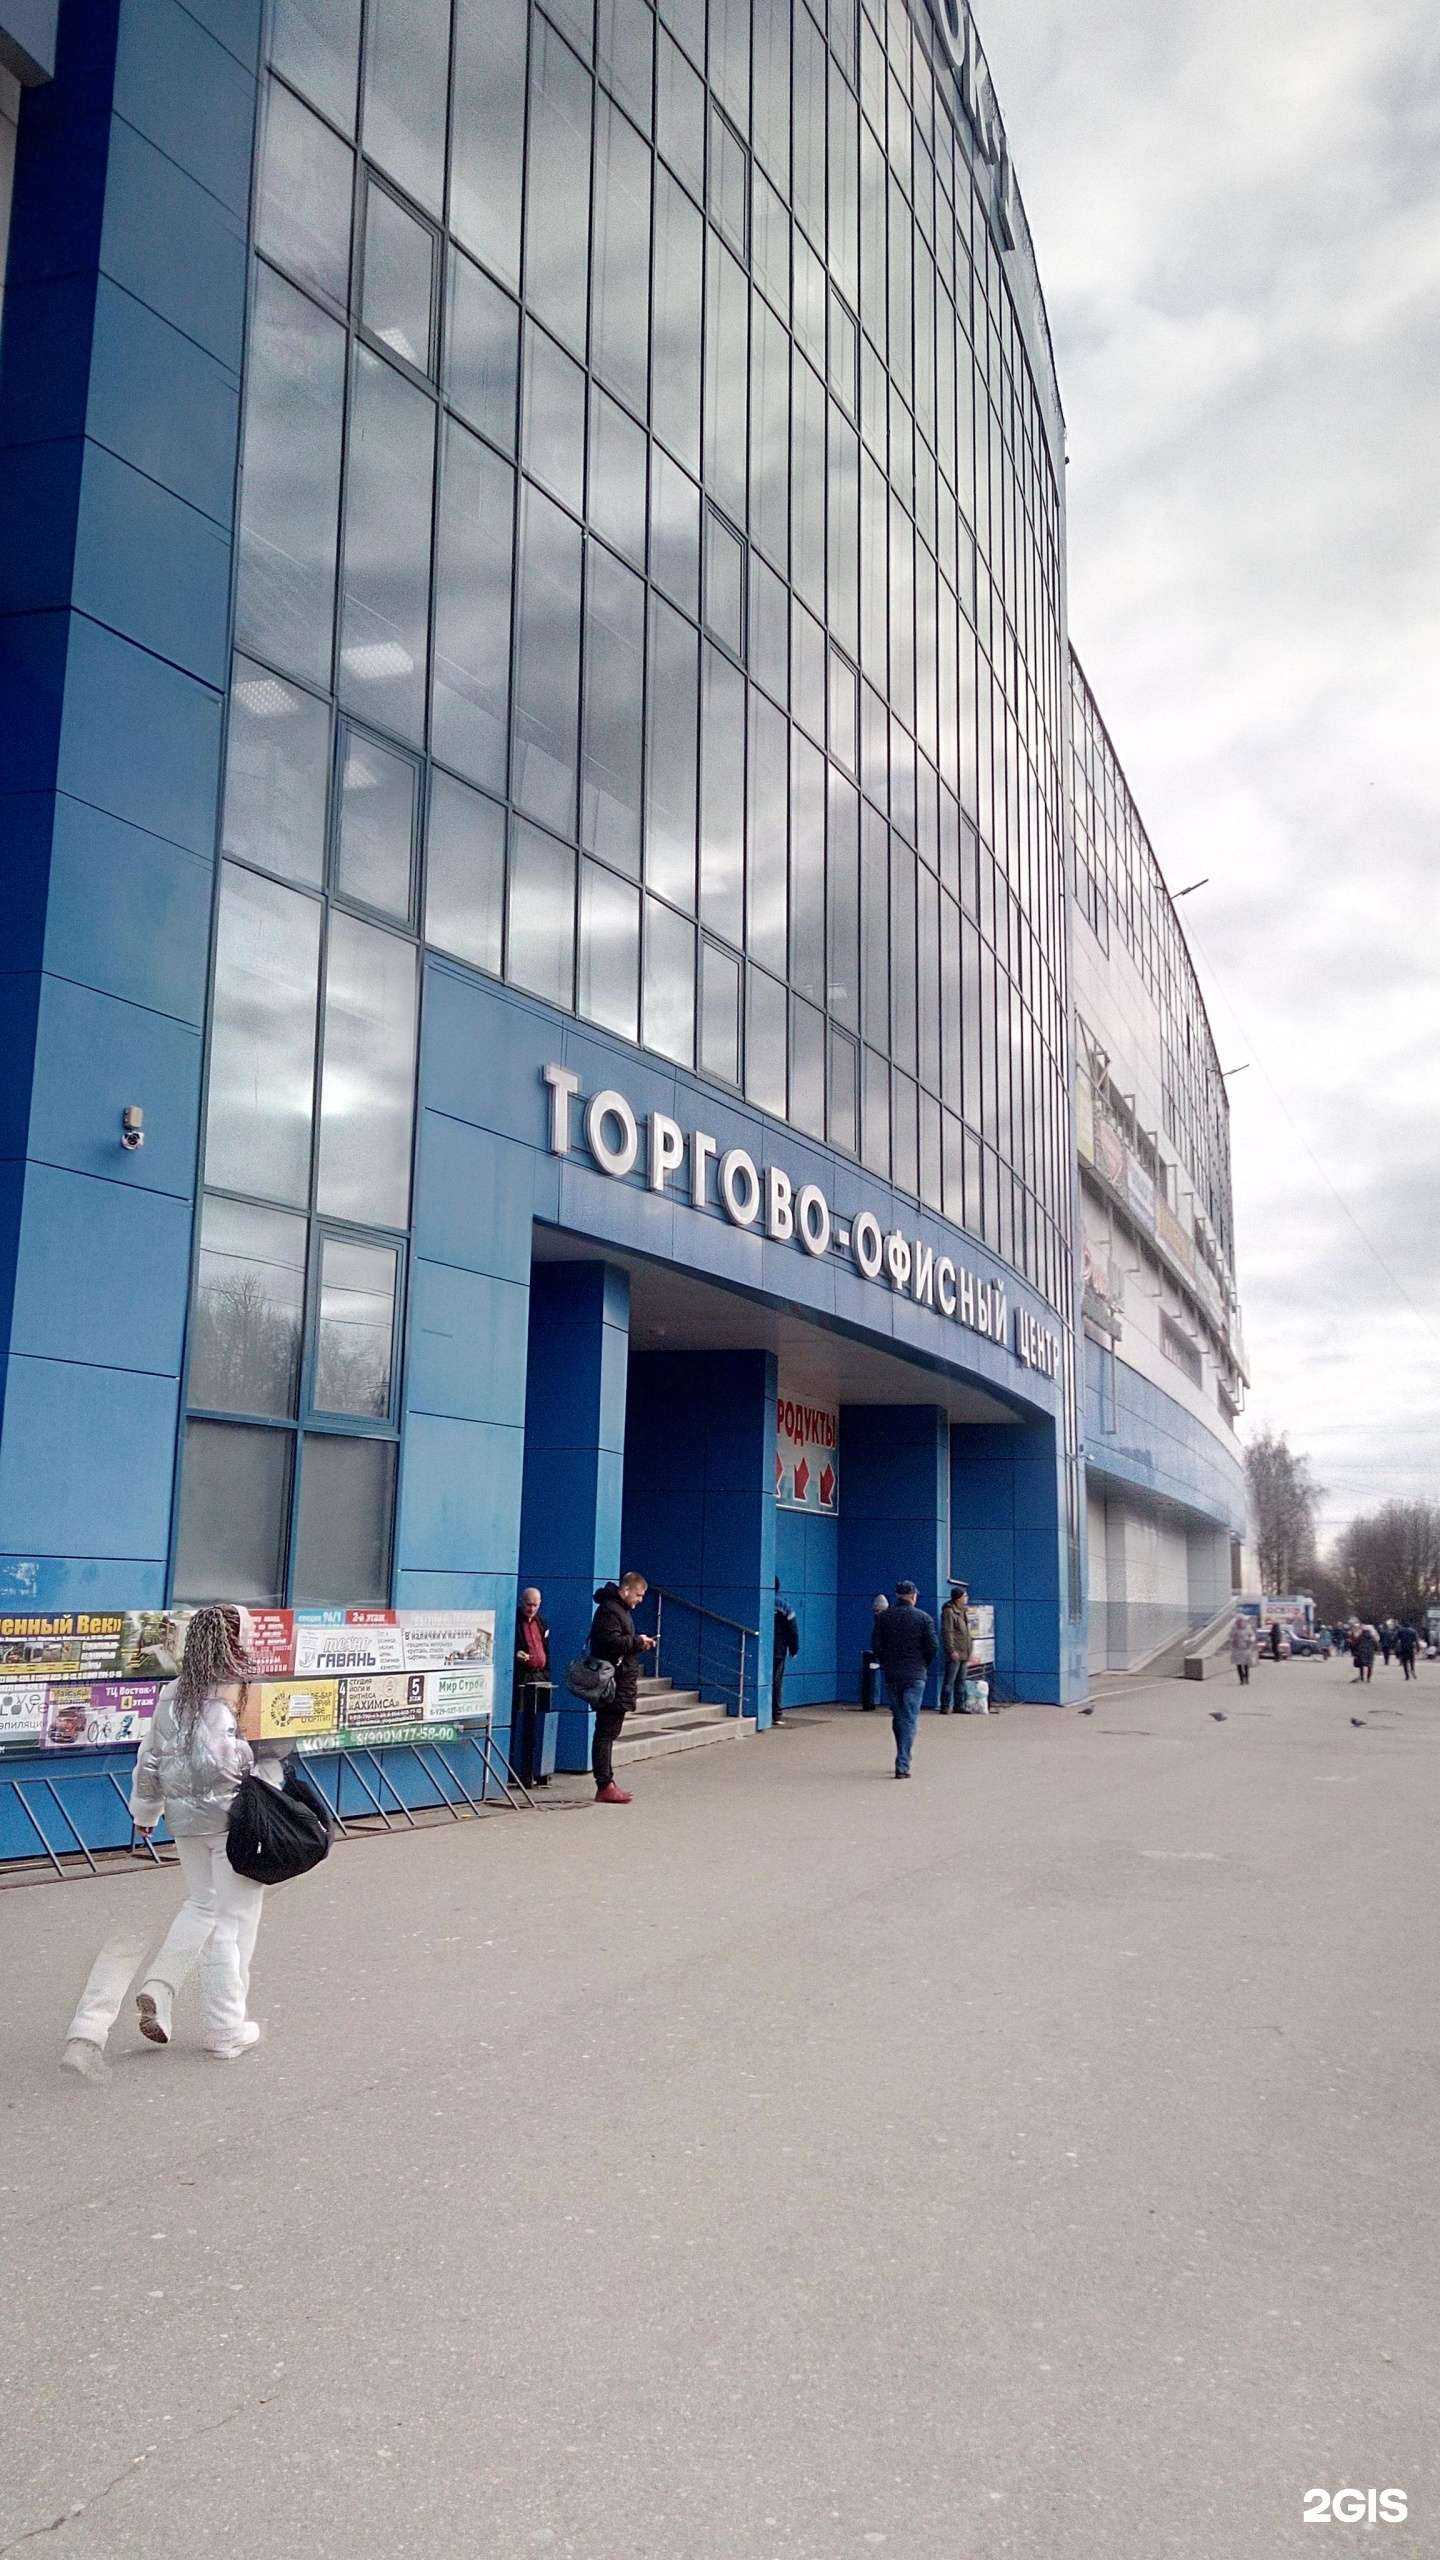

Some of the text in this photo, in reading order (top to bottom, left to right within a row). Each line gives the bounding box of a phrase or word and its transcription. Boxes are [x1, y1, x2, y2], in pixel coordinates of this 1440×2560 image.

[541, 1062, 1060, 1380] ТОРГОВО-ОФИСНЫЙ ЦЕНТР
[317, 1652, 376, 1668] ГАВАНЬ
